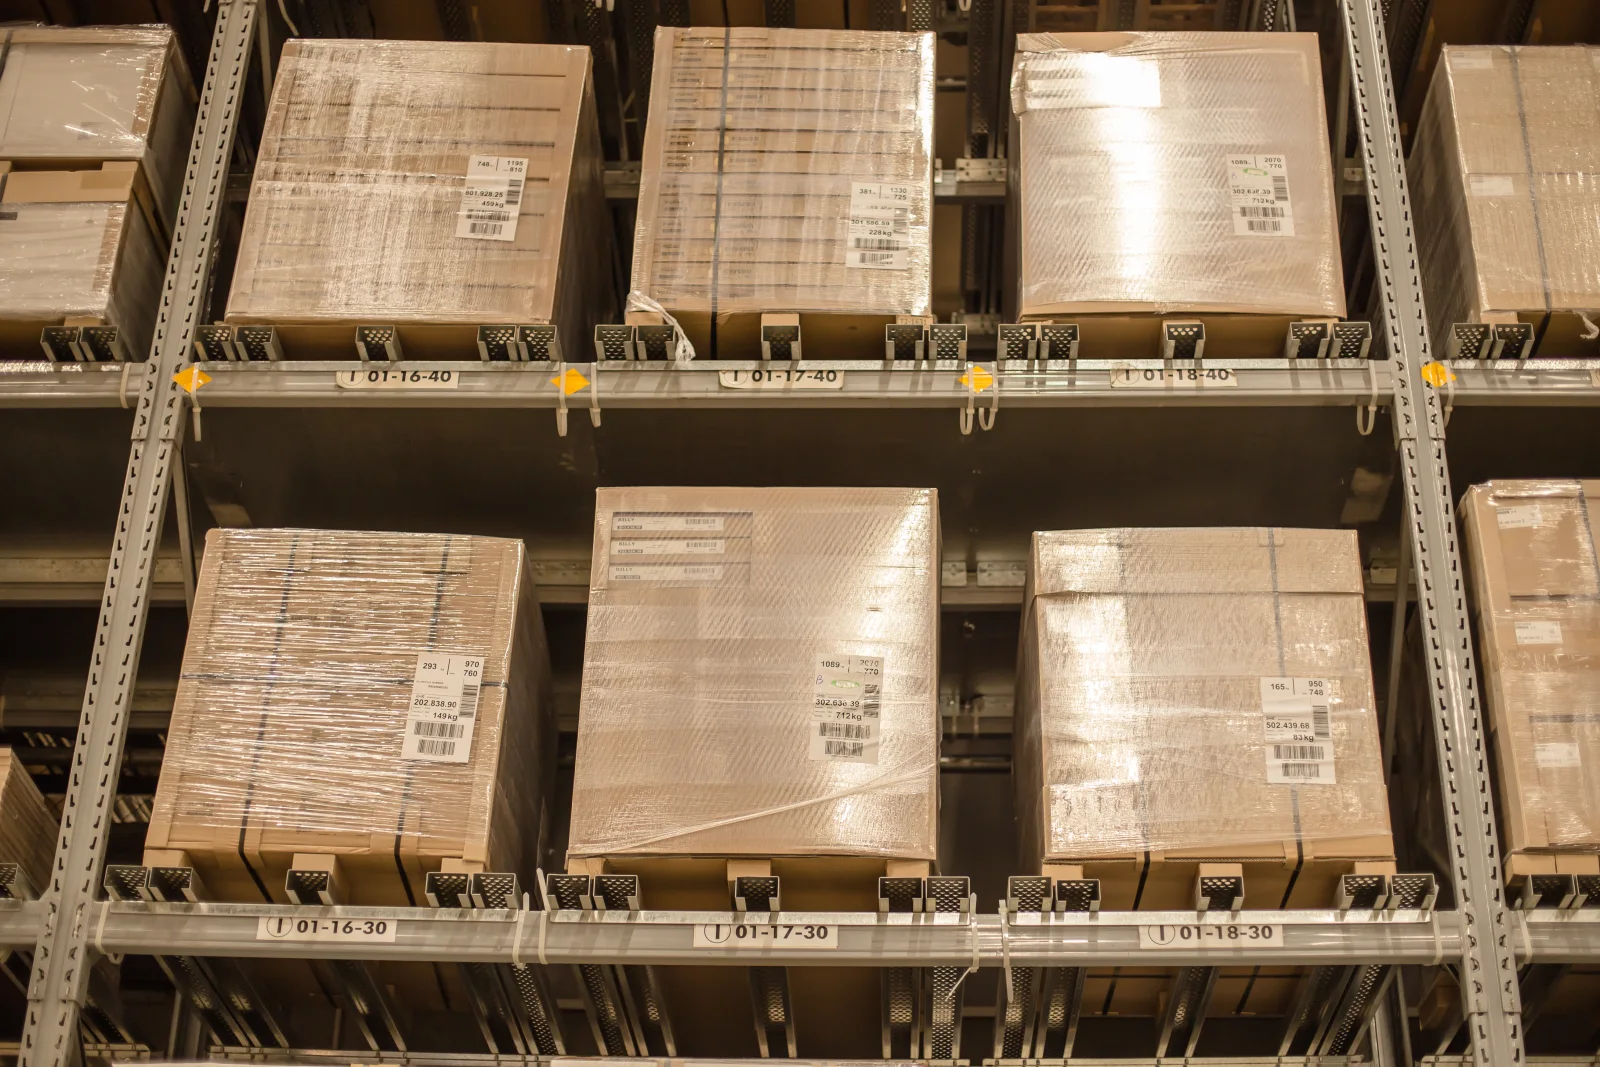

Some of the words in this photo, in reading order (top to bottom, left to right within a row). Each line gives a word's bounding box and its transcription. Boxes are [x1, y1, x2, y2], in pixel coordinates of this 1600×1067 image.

[367, 370, 452, 383] 01-16-40
[752, 370, 837, 382] 01-17-40
[1143, 369, 1230, 381] 01-18-40
[422, 662, 437, 670] 293
[414, 699, 457, 708] 202.838.90
[296, 920, 387, 935] 01-16-30
[735, 925, 828, 940] 01-17-30
[1180, 925, 1273, 940] 01-18-30
